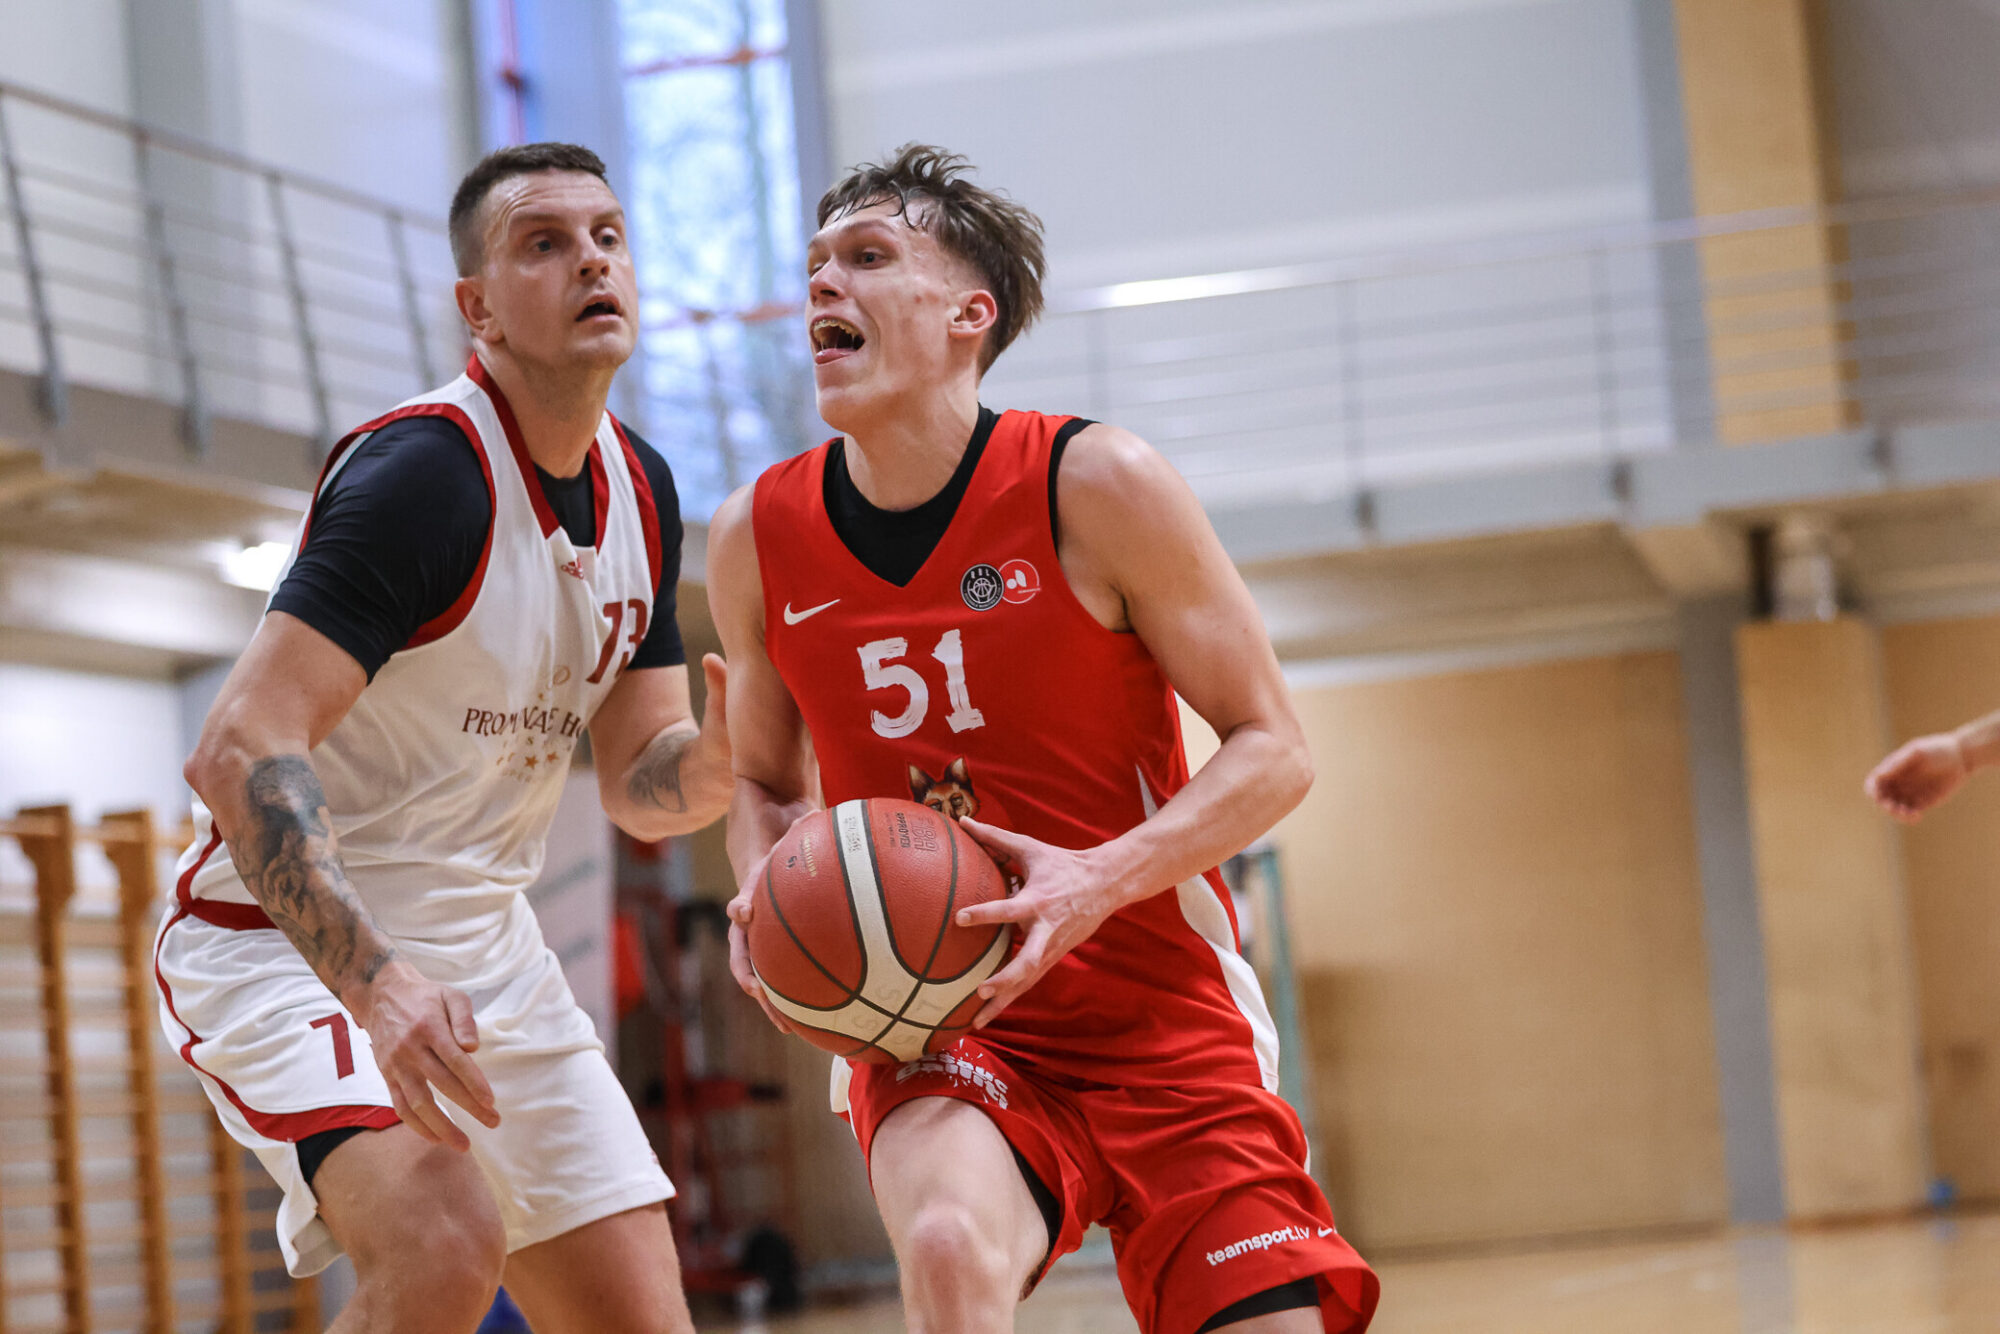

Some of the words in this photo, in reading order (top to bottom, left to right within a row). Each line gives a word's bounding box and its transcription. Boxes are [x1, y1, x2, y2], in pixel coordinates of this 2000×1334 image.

[585, 598, 649, 685] 73
[856, 628, 986, 739] 51
[1206, 1225, 1310, 1266] teamsport.lv
